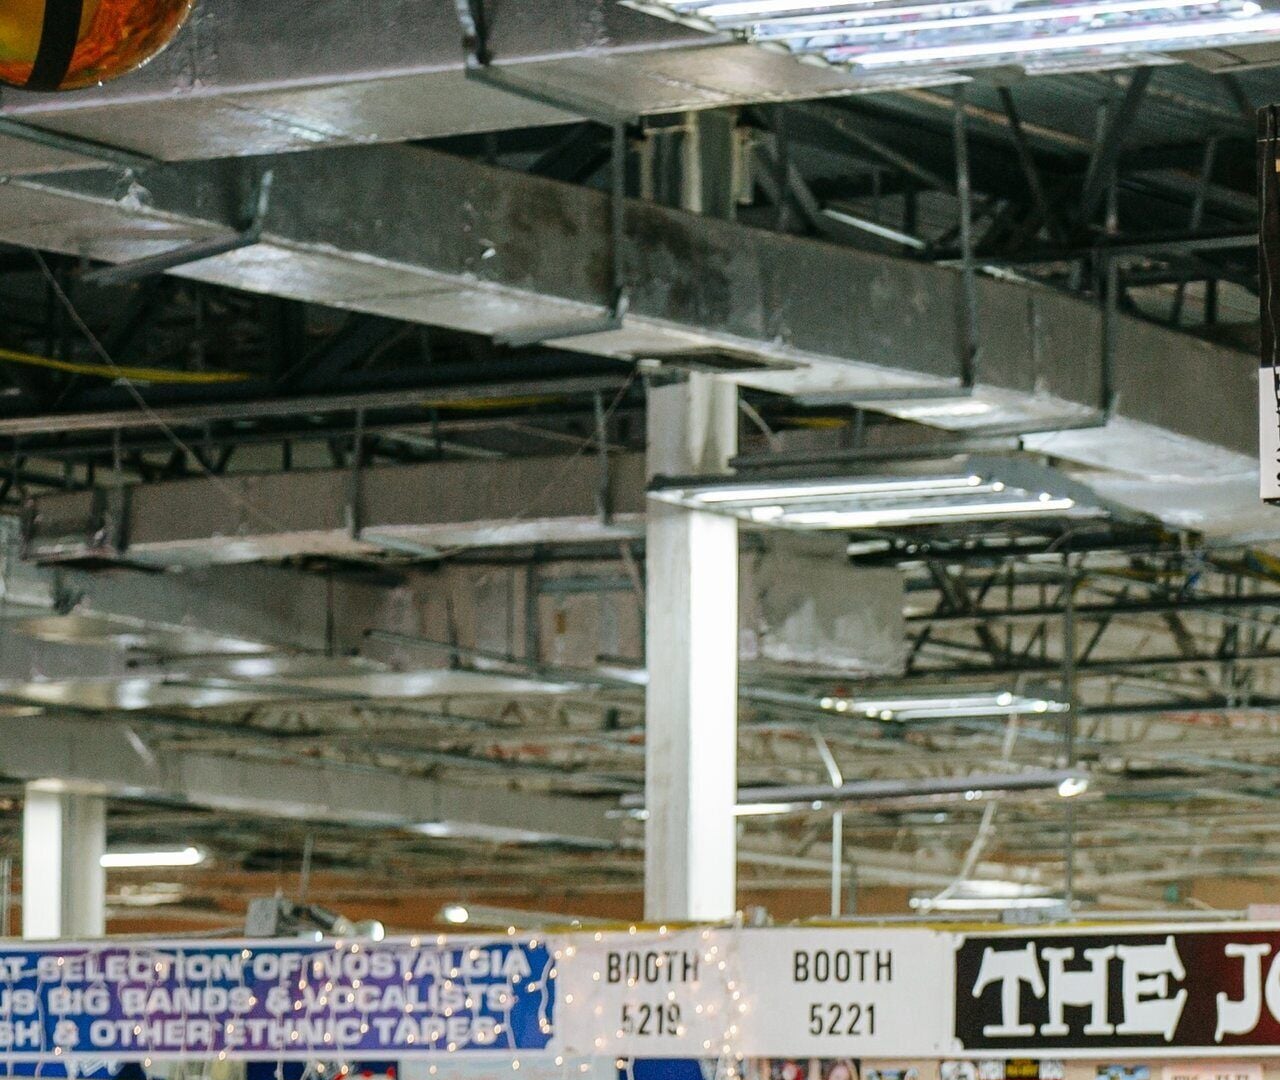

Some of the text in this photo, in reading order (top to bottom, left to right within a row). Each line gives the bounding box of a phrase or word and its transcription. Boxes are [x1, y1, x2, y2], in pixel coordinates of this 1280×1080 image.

[38, 950, 531, 983] SELECTION OF NOSTALGIA
[607, 951, 700, 983] BOOTH
[793, 950, 894, 982] BOOTH
[48, 984, 515, 1017] BIG BANDS & VOCALISTS
[972, 934, 1189, 1042] THE
[90, 1018, 211, 1047] OTHER
[225, 1016, 362, 1047] ETHNIC
[373, 1015, 498, 1046] TAPES
[621, 1003, 682, 1036] 5219
[809, 1002, 876, 1036] 5221
